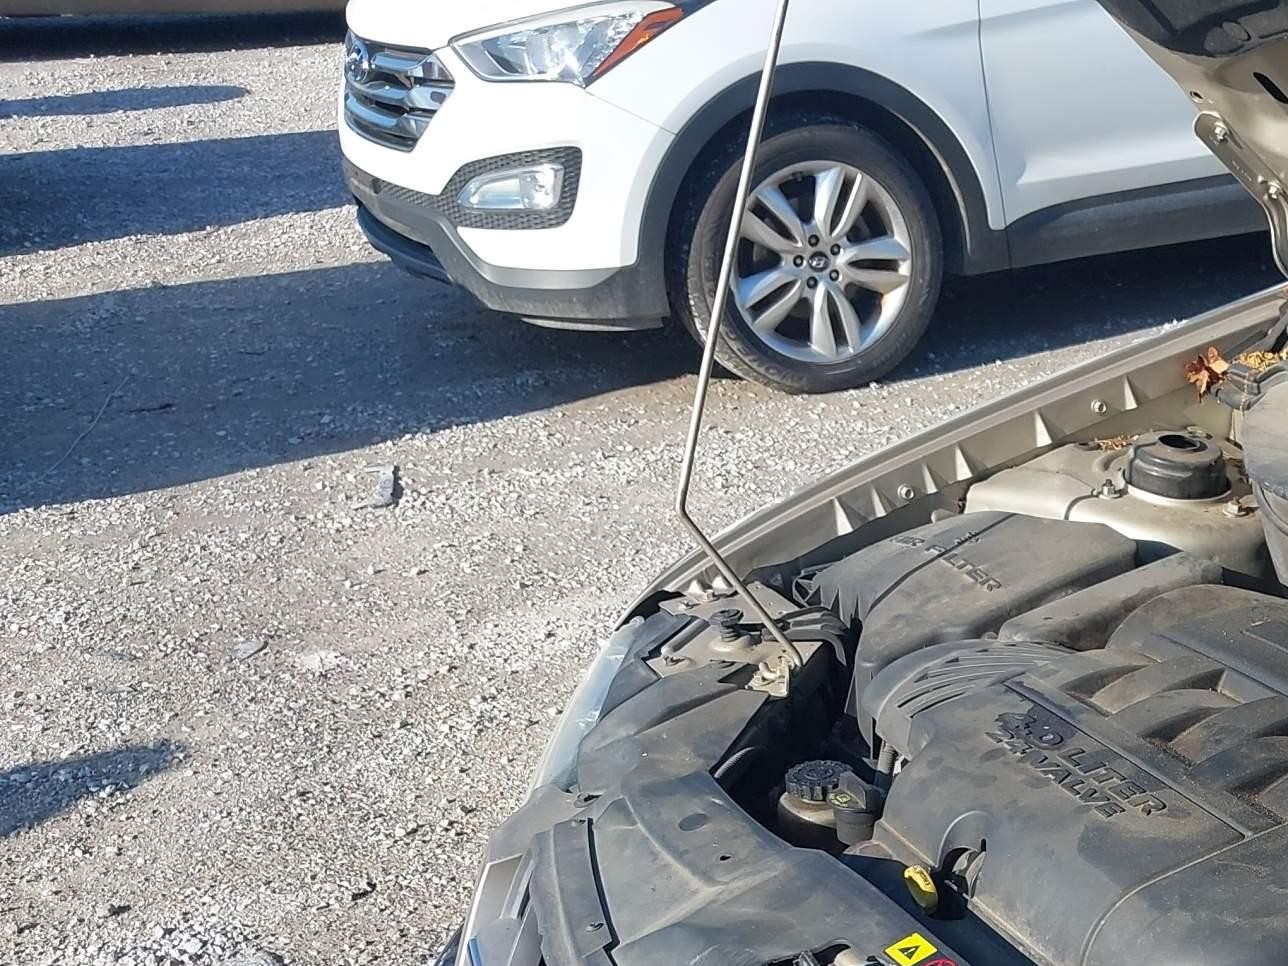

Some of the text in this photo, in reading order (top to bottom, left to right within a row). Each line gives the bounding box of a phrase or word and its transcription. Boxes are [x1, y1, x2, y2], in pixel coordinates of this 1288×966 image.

[924, 544, 1003, 592] FLTER
[1032, 752, 1127, 819] VALVE
[1056, 748, 1168, 817] LITER
